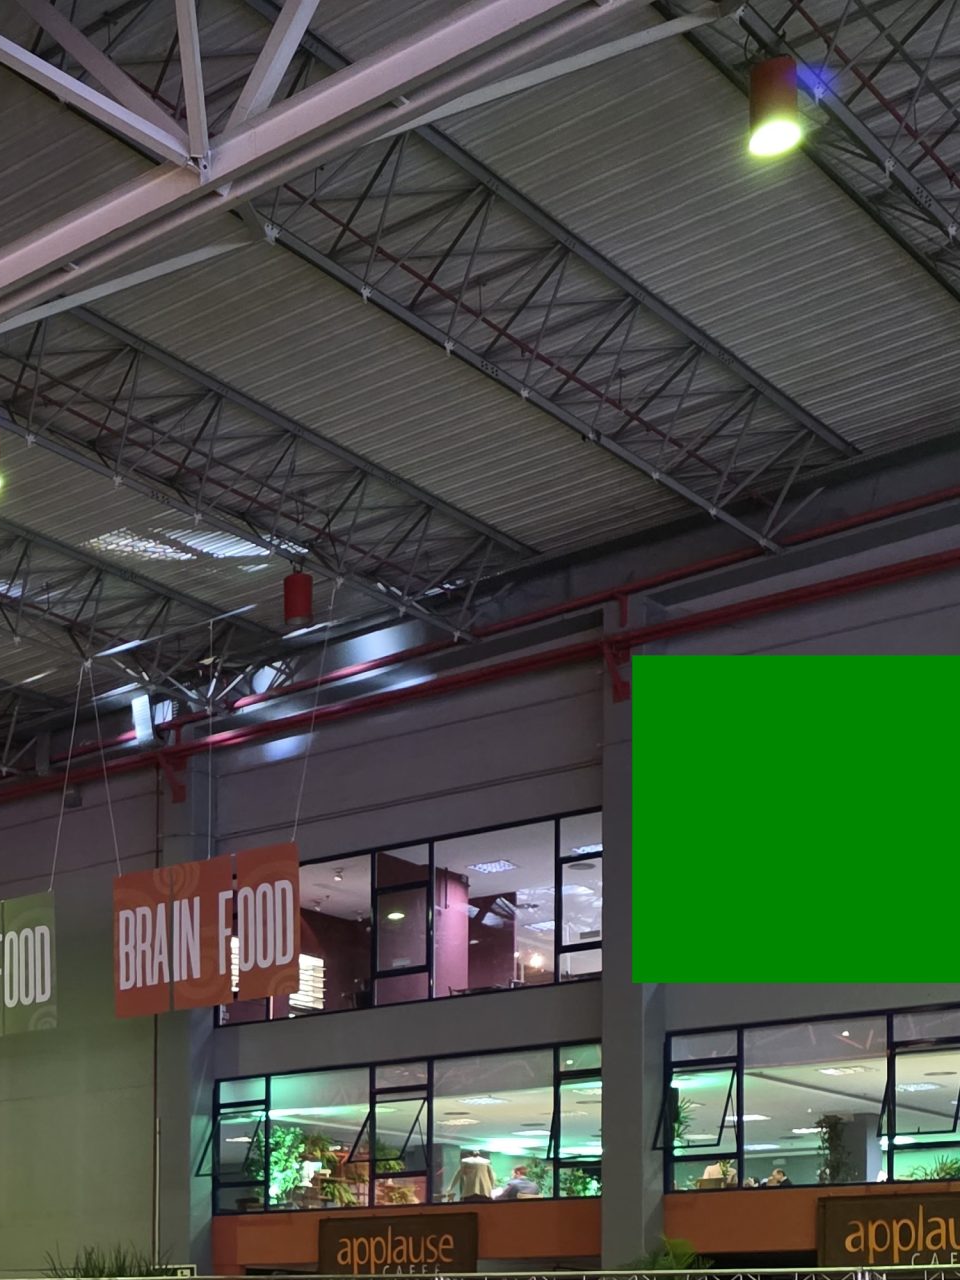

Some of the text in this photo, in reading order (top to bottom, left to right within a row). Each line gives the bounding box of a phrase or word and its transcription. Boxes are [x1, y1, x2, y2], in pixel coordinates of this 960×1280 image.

[119, 879, 295, 991] BRAIN FOOD
[337, 1225, 455, 1275] applause
